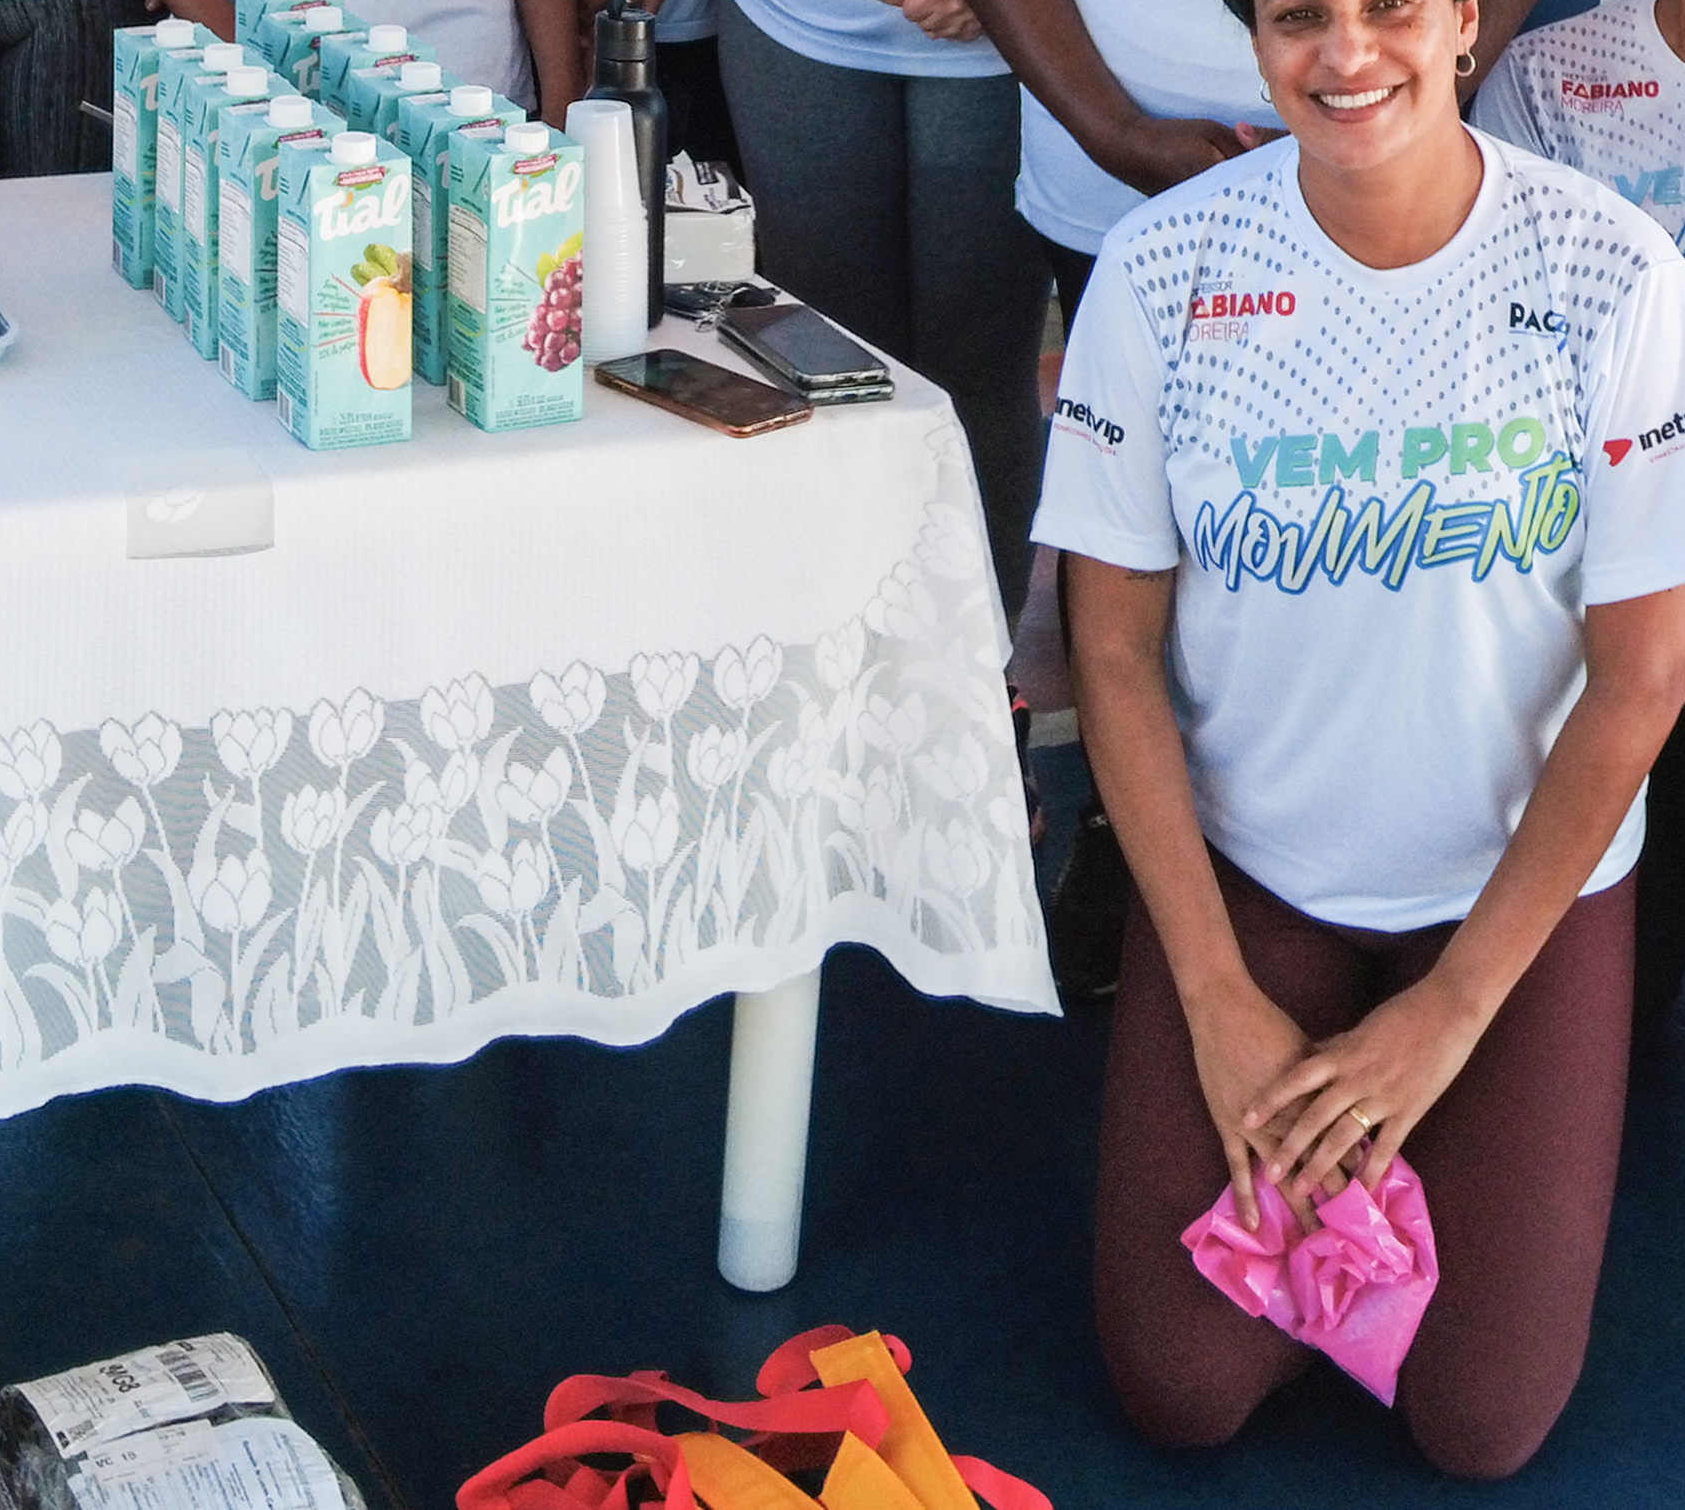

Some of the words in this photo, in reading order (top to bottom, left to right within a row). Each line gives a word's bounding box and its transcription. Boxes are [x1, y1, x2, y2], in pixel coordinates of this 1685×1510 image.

[1561, 79, 1660, 100] FABIANO
[313, 174, 410, 240] Tial
[491, 161, 582, 228] Tial
[1190, 289, 1296, 321] ABIANO
[1231, 429, 1380, 490] VEM
[1401, 415, 1547, 480] PRO
[1192, 449, 1587, 594] MOVIMENTO
